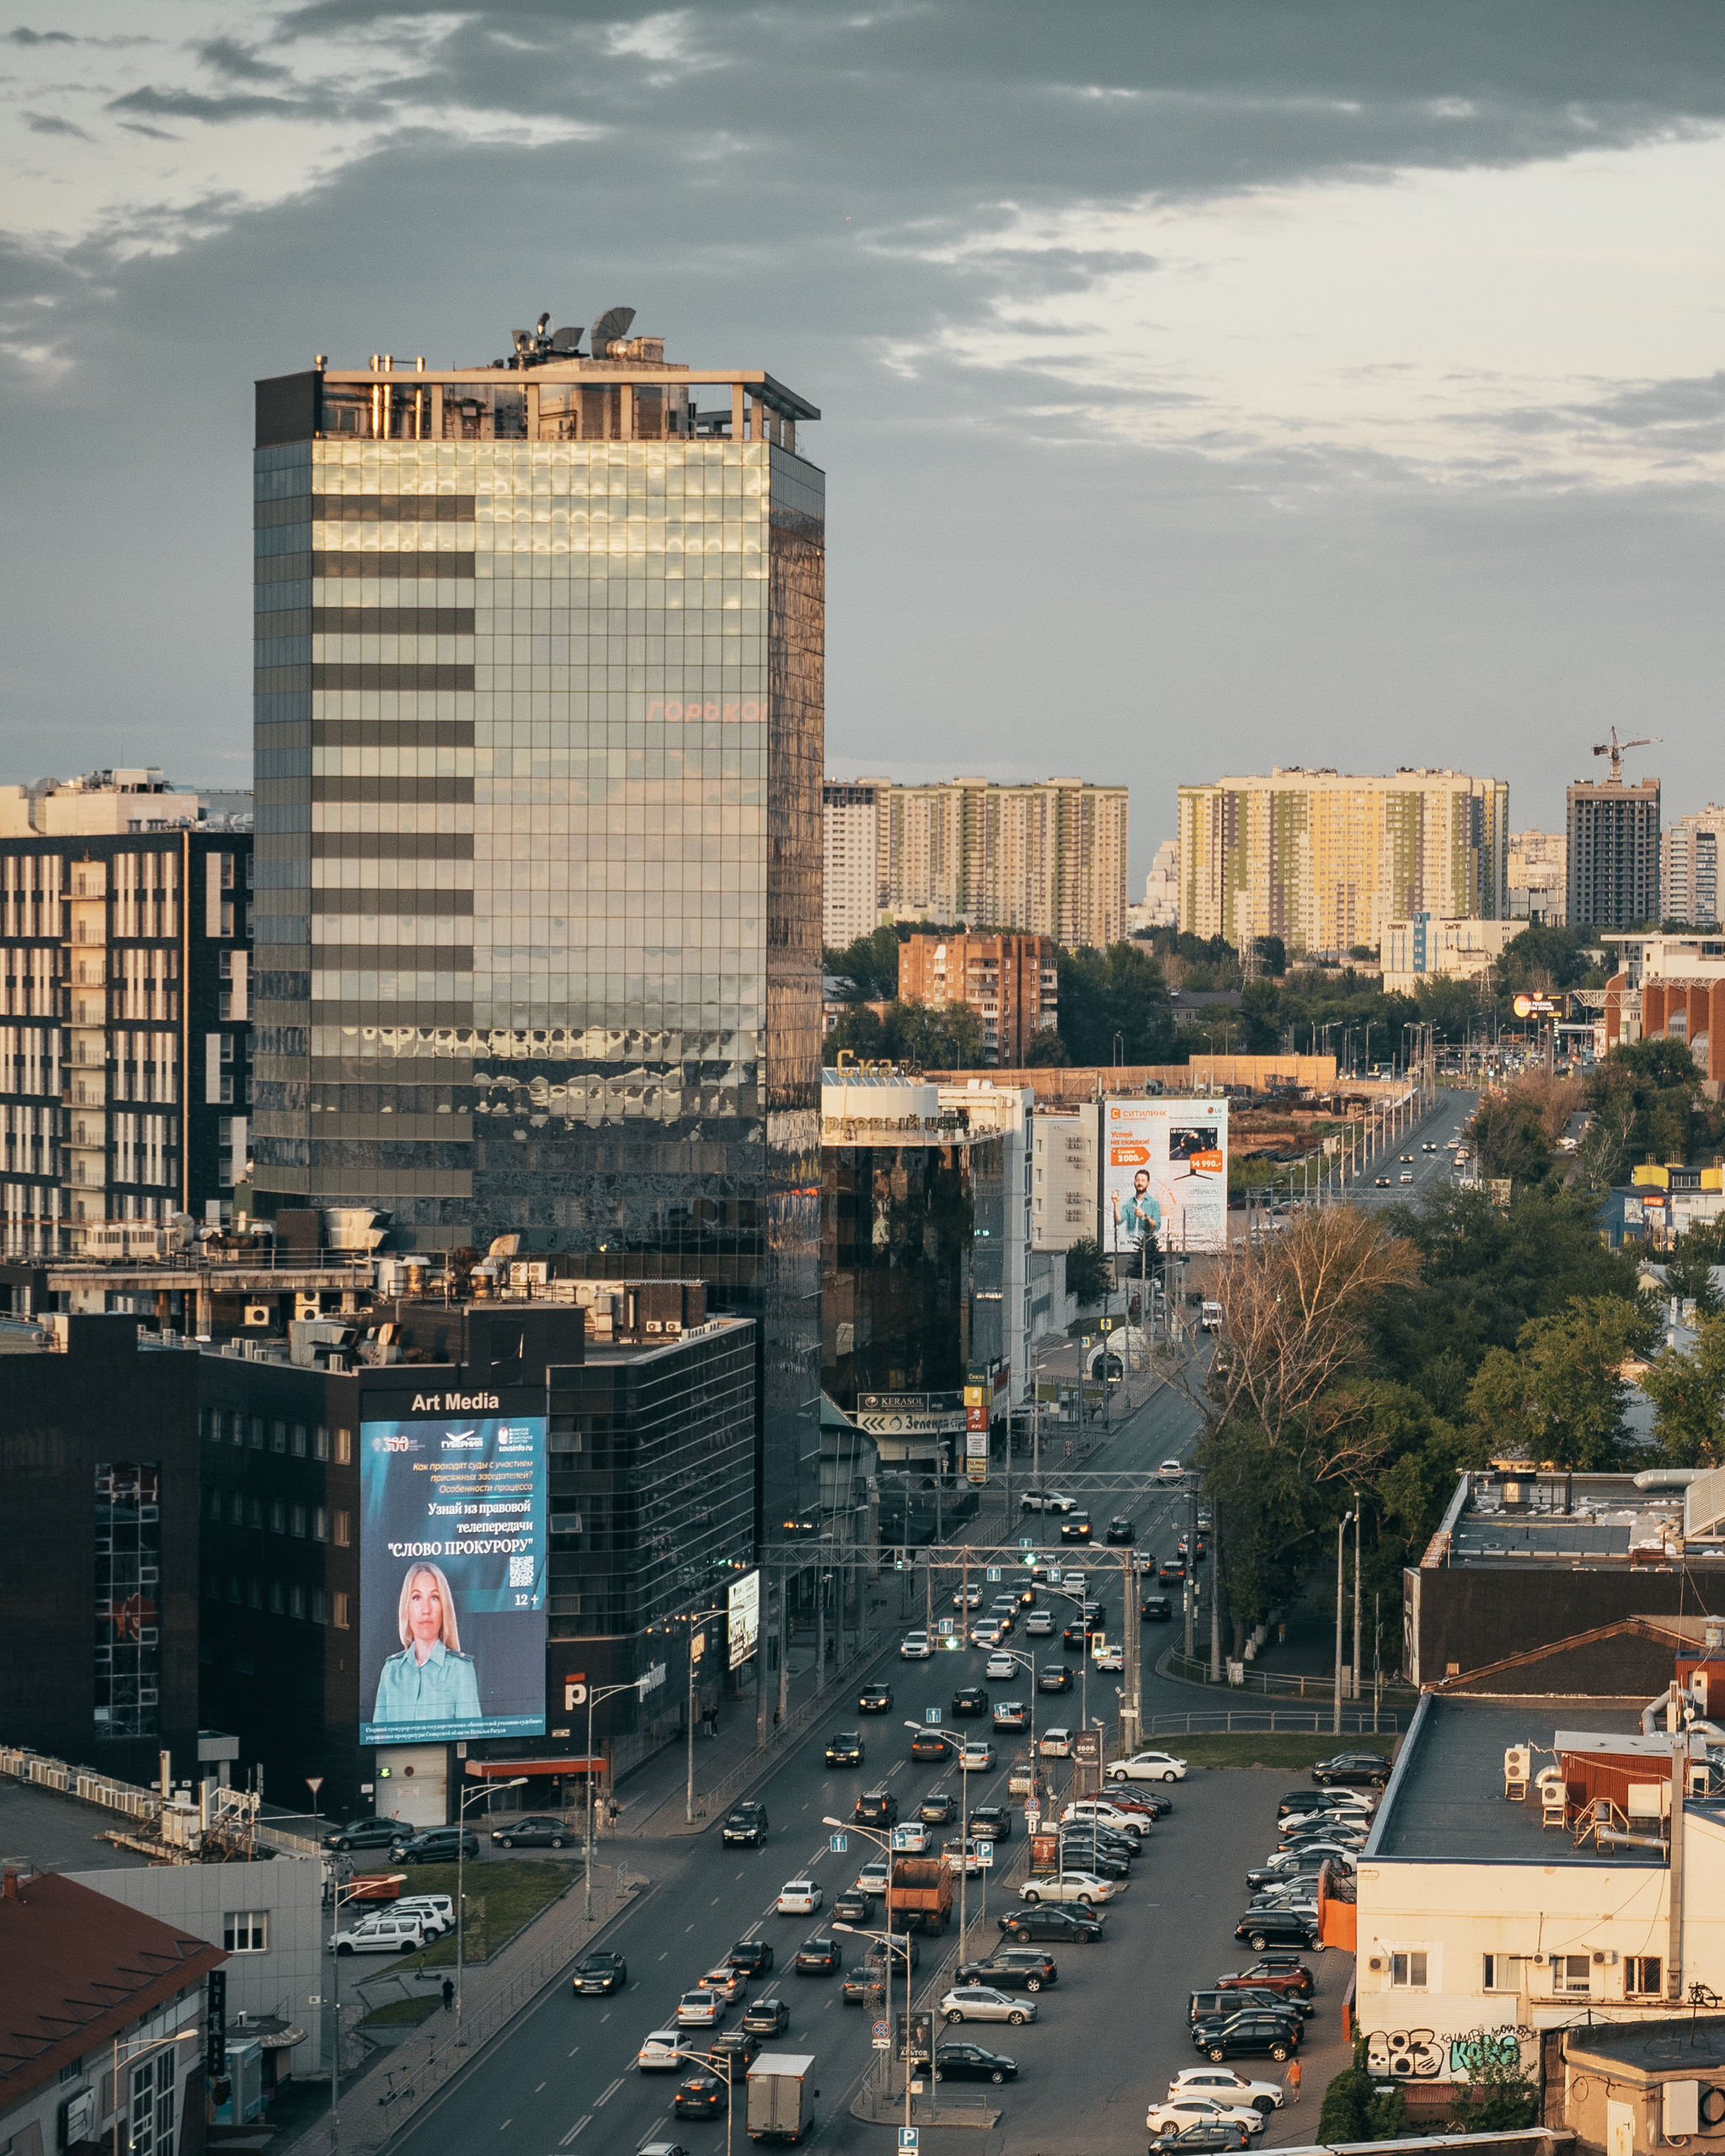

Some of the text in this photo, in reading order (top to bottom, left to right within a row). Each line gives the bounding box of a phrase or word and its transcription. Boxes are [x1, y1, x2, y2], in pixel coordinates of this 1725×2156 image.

[836, 1049, 923, 1077] Скала
[411, 1392, 499, 1412] Art Media
[413, 1463, 428, 1471] Как
[430, 1462, 467, 1472] проходят
[467, 1462, 488, 1471] суды
[494, 1460, 533, 1470] участием
[430, 1470, 533, 1483] присяжных заседателей?
[439, 1483, 533, 1494] Особенности процесса
[428, 1500, 531, 1517] Узнай из правовой
[457, 1521, 533, 1535] телепередачи
[387, 1538, 533, 1557] "СЛОВО ПРОКУРОРУ"
[515, 1594, 528, 1606] 12
